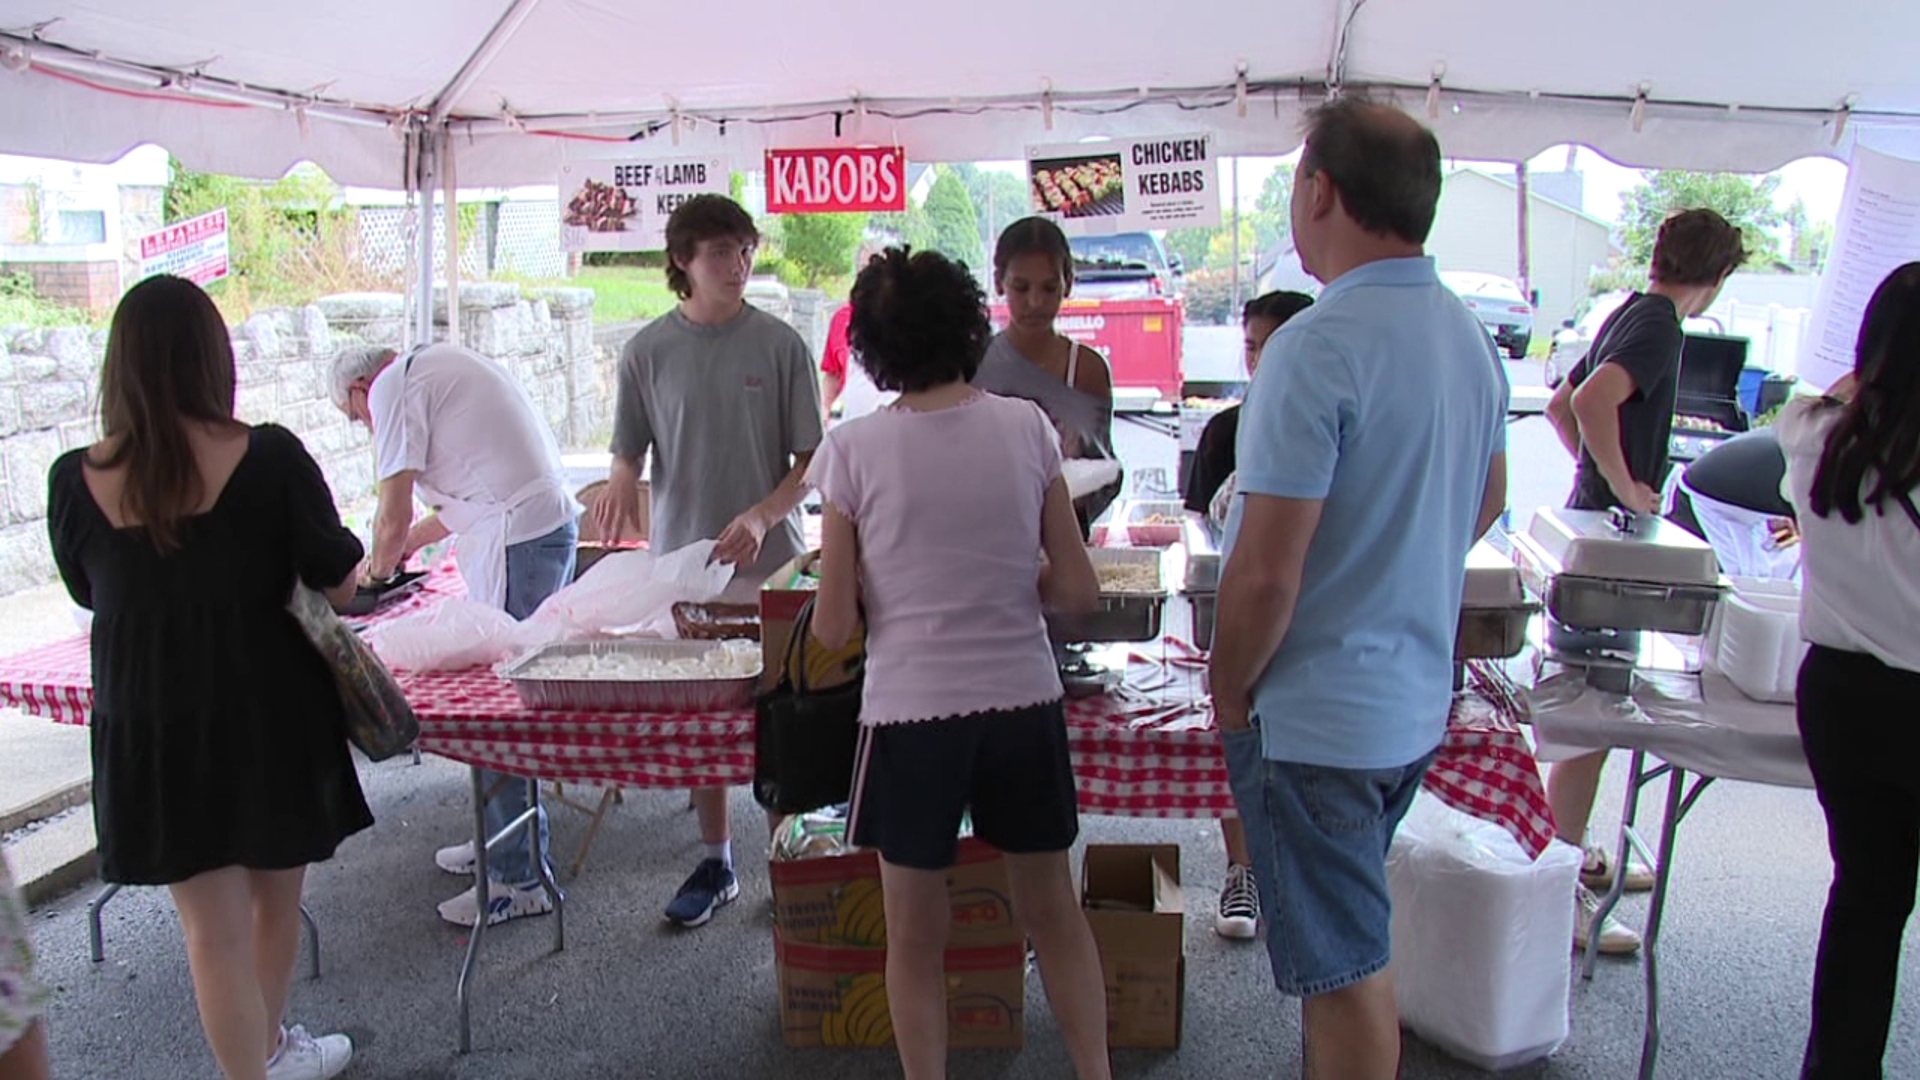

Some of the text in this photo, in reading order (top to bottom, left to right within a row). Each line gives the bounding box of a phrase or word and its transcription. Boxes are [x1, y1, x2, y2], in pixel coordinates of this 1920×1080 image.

[1132, 139, 1206, 166] CHICKEN
[615, 165, 653, 187] BEEF
[664, 164, 706, 185] LAMB
[772, 154, 898, 205] KABOBS
[1139, 171, 1204, 196] KEBABS
[657, 194, 700, 215] KEB
